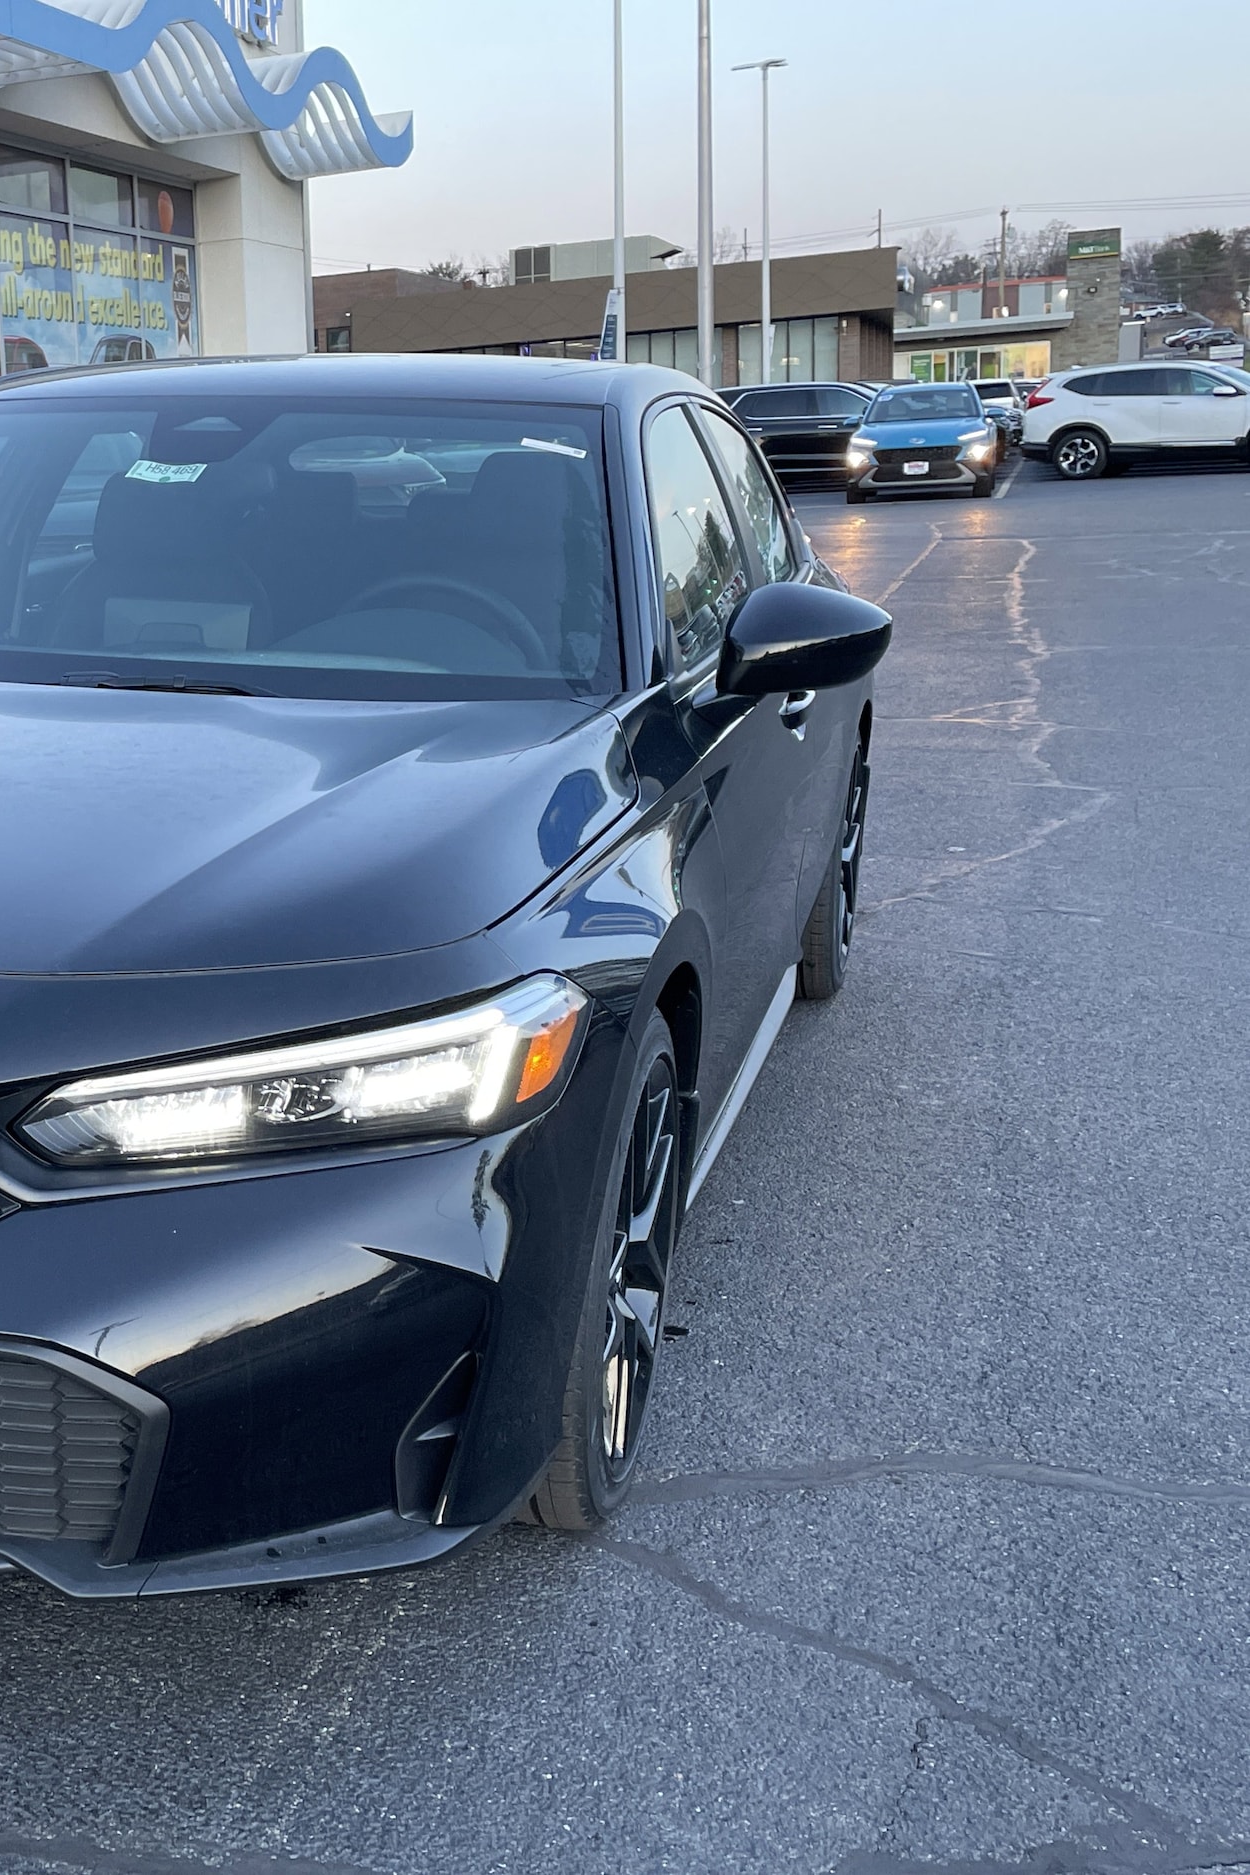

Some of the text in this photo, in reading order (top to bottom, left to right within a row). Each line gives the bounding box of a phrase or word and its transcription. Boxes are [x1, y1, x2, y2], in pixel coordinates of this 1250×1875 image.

[27, 221, 57, 269] the
[60, 239, 95, 275] new
[98, 241, 165, 283] standard
